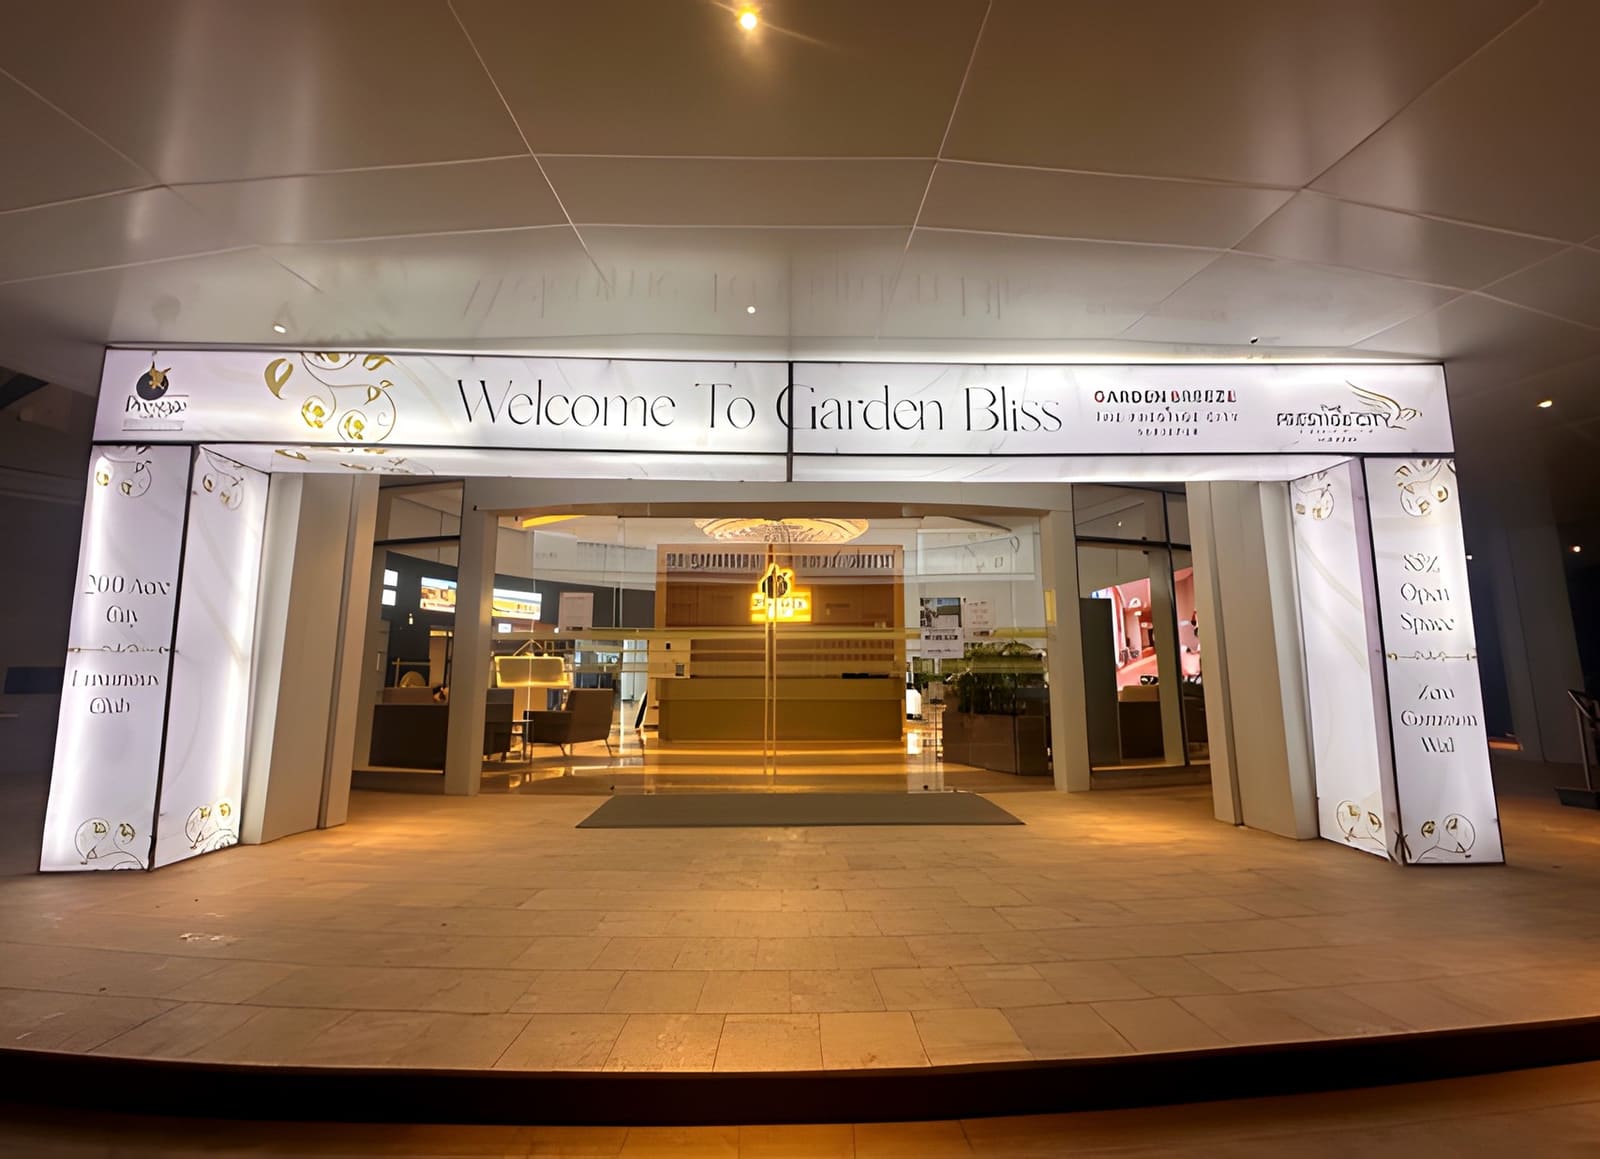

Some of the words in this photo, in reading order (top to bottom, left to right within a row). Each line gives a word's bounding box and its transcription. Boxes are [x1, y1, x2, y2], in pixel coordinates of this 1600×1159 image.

[457, 379, 676, 427] Welcome
[695, 383, 756, 429] To
[776, 384, 943, 431] Garden
[965, 385, 1062, 432] Bliss
